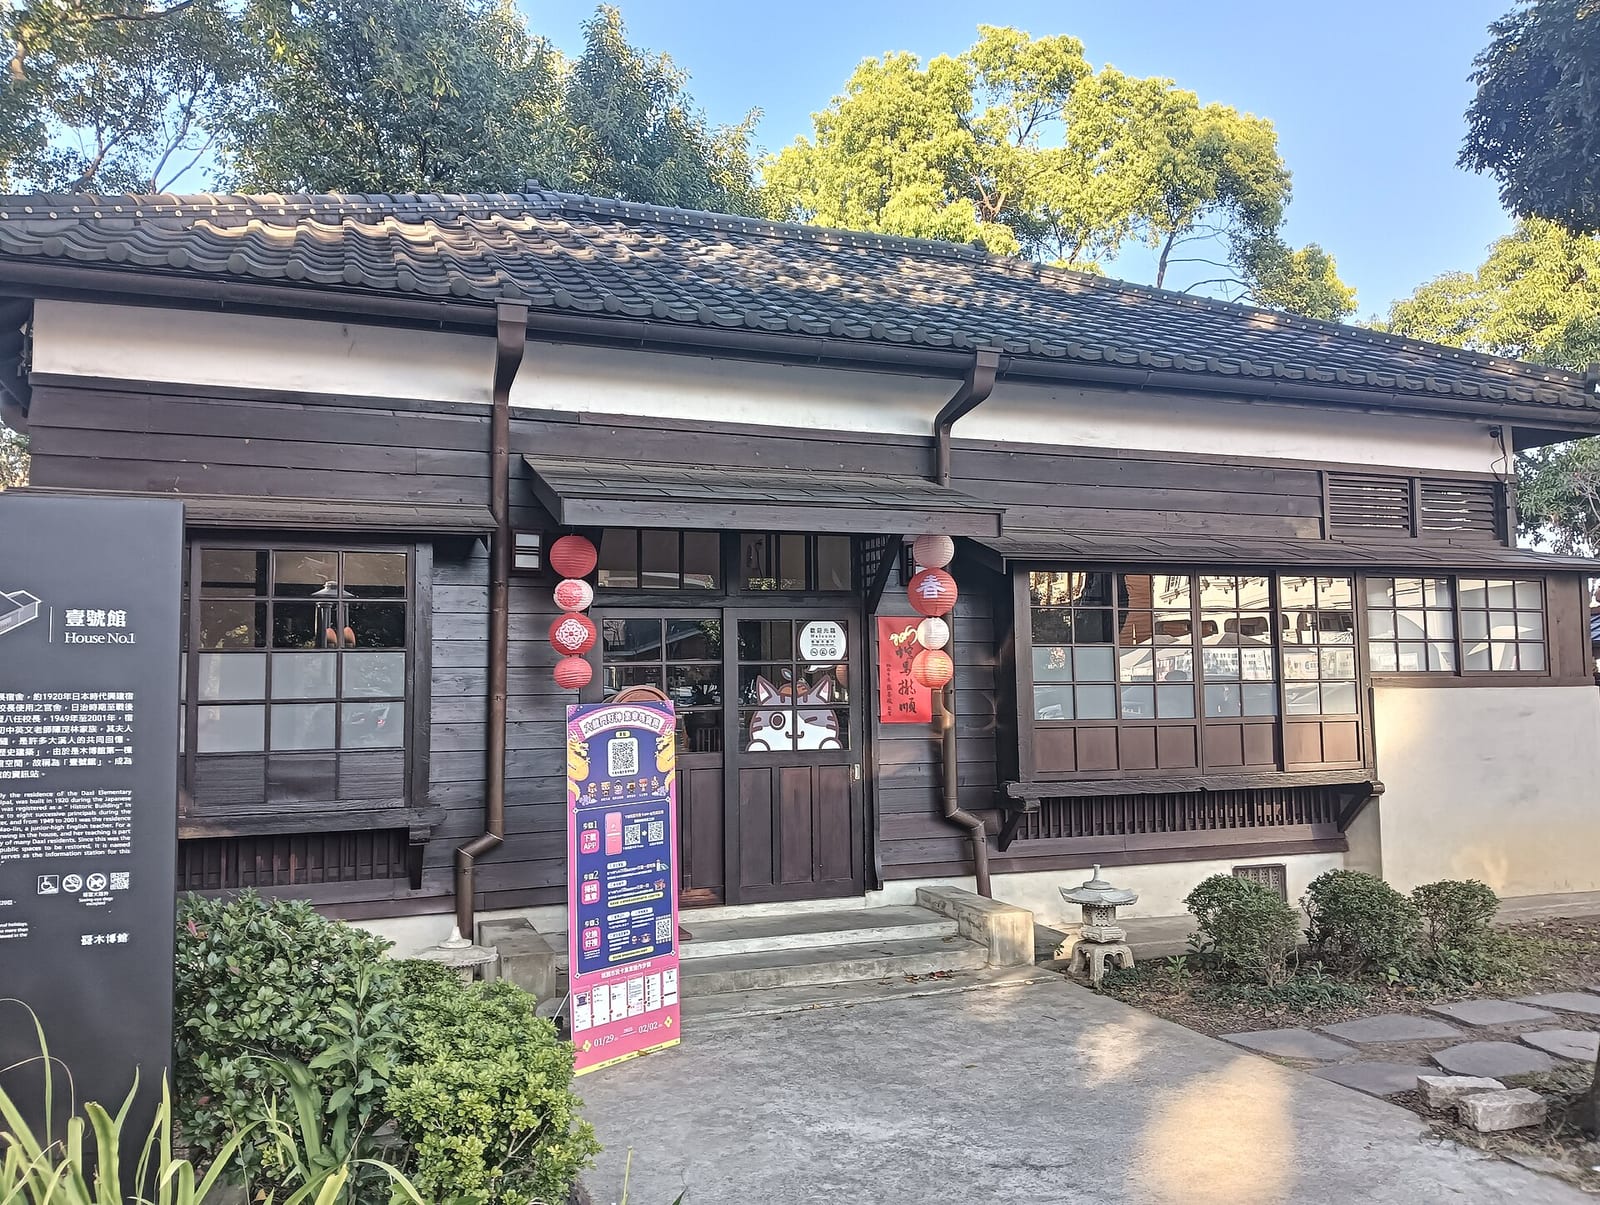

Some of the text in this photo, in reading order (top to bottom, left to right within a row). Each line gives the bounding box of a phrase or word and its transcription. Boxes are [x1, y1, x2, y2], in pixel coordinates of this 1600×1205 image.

[915, 574, 946, 599] 春
[65, 609, 127, 628] 壹號館
[64, 632, 136, 644] House No.1
[584, 833, 597, 842] 下載
[583, 842, 597, 850] APP
[638, 1021, 659, 1034] 02/02
[593, 1034, 615, 1048] 01/29
